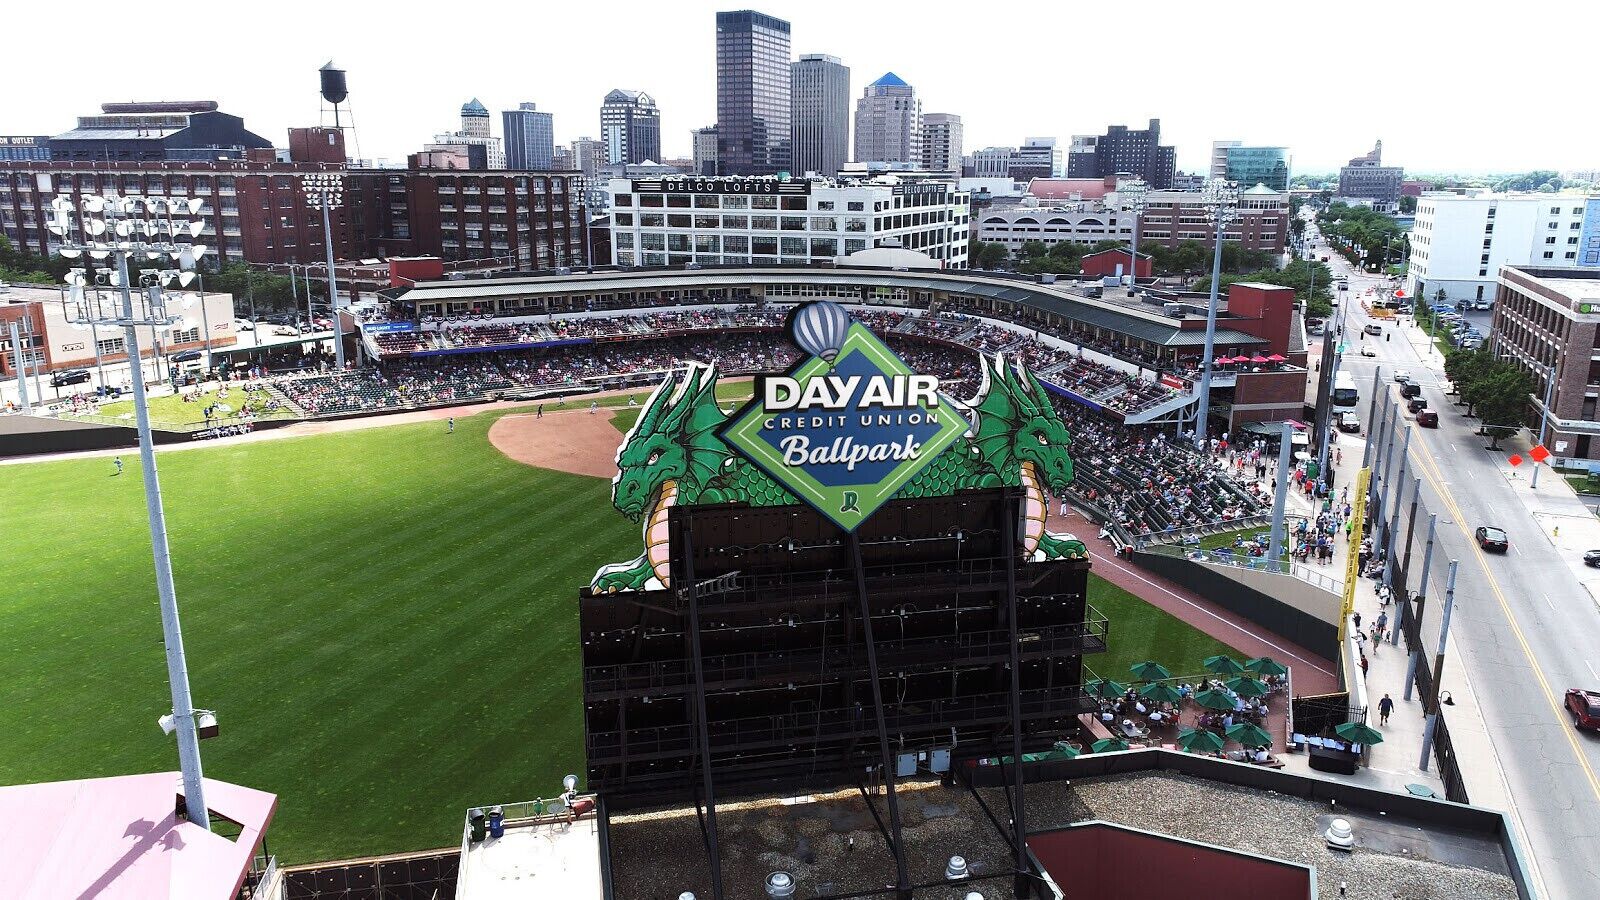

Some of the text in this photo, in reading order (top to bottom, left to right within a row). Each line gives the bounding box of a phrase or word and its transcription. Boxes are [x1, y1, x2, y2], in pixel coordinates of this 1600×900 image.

[668, 183, 771, 192] DELCO LOFTS
[904, 185, 937, 194] DELCO LOFTS
[62, 343, 84, 351] OPEN
[764, 375, 940, 411] DAY AIR
[763, 413, 939, 431] CREDIT UNION
[779, 434, 923, 471] Ballpark
